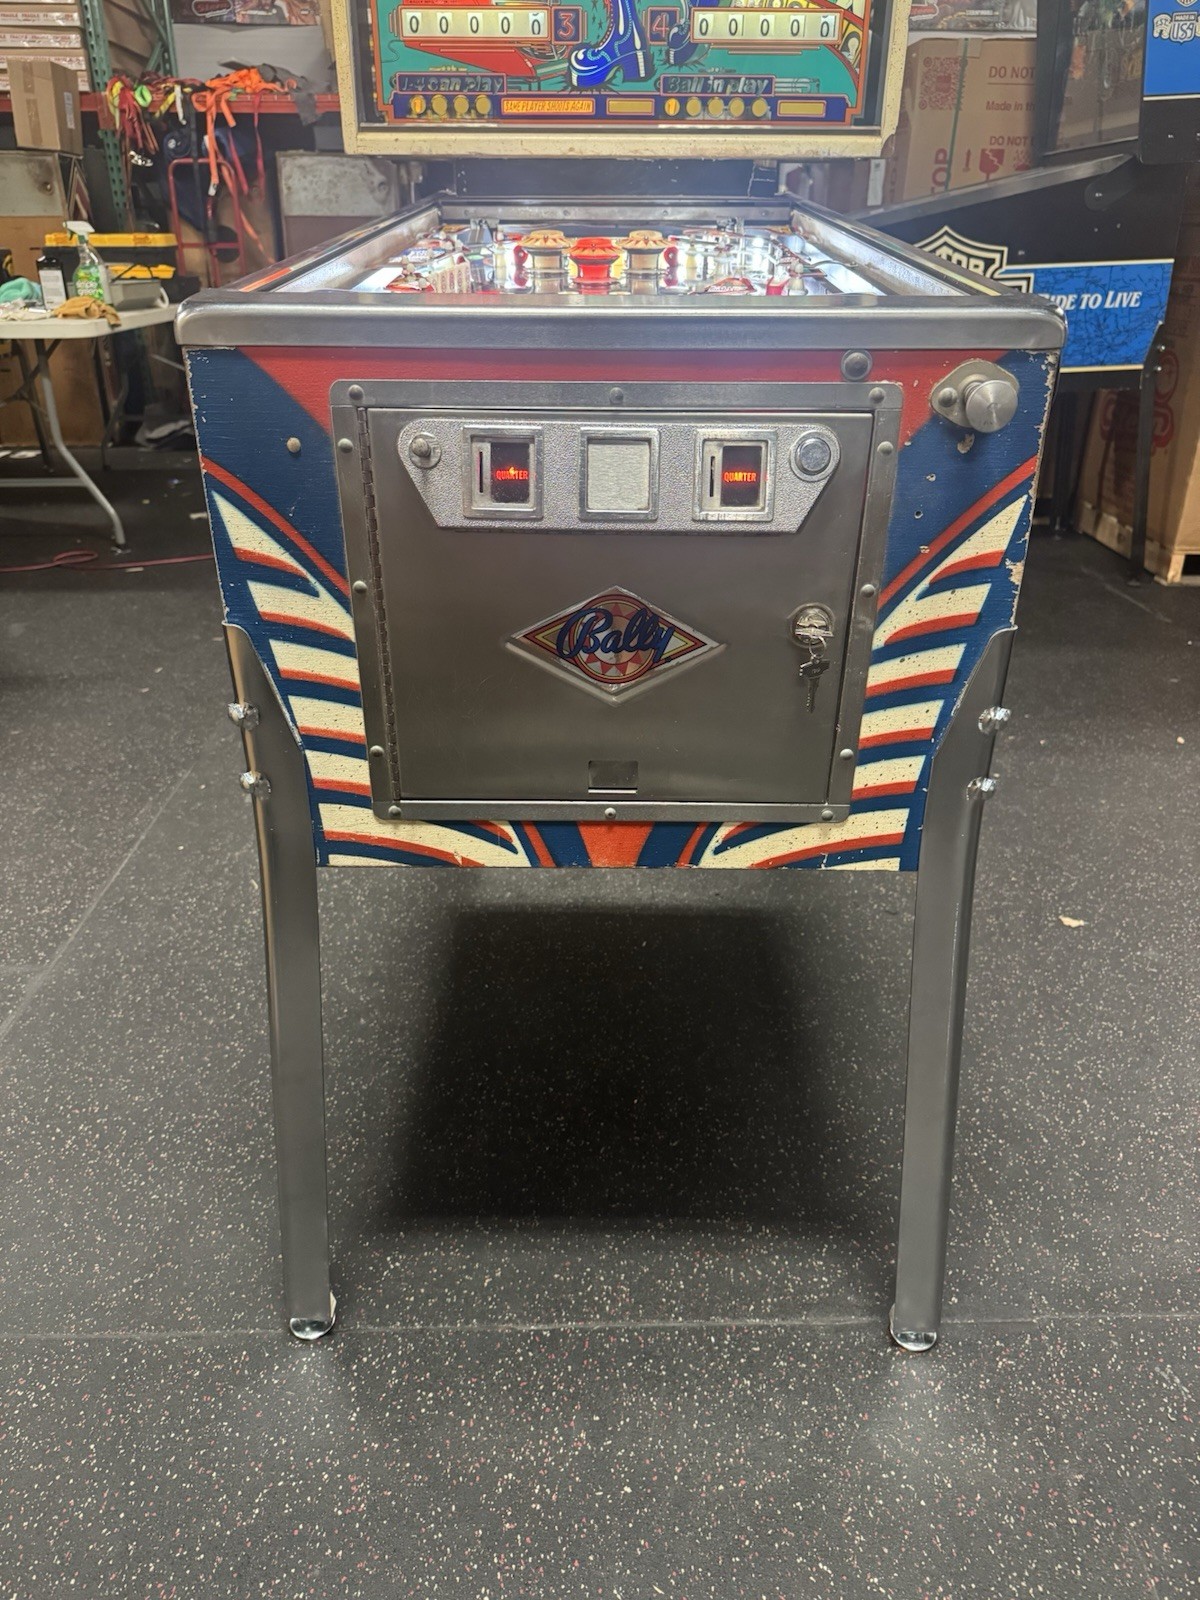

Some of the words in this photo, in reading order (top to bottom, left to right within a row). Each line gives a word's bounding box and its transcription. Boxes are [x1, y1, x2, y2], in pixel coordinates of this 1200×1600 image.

[558, 12, 574, 38] 3
[652, 12, 669, 38] 4
[1171, 22, 1194, 40] USA
[988, 65, 1007, 79] DO
[1010, 65, 1035, 80] NOT
[427, 77, 461, 91] can
[463, 75, 503, 96] play
[726, 76, 769, 97] play
[570, 101, 591, 112] AGAIN
[985, 101, 1011, 111] Made
[1014, 101, 1023, 111] in
[989, 136, 1004, 146] DO
[1006, 136, 1030, 146] NOT
[1079, 293, 1102, 310] TO
[496, 470, 529, 480] QUARTER
[724, 472, 757, 482] QUARTER
[556, 608, 675, 663] Bally
